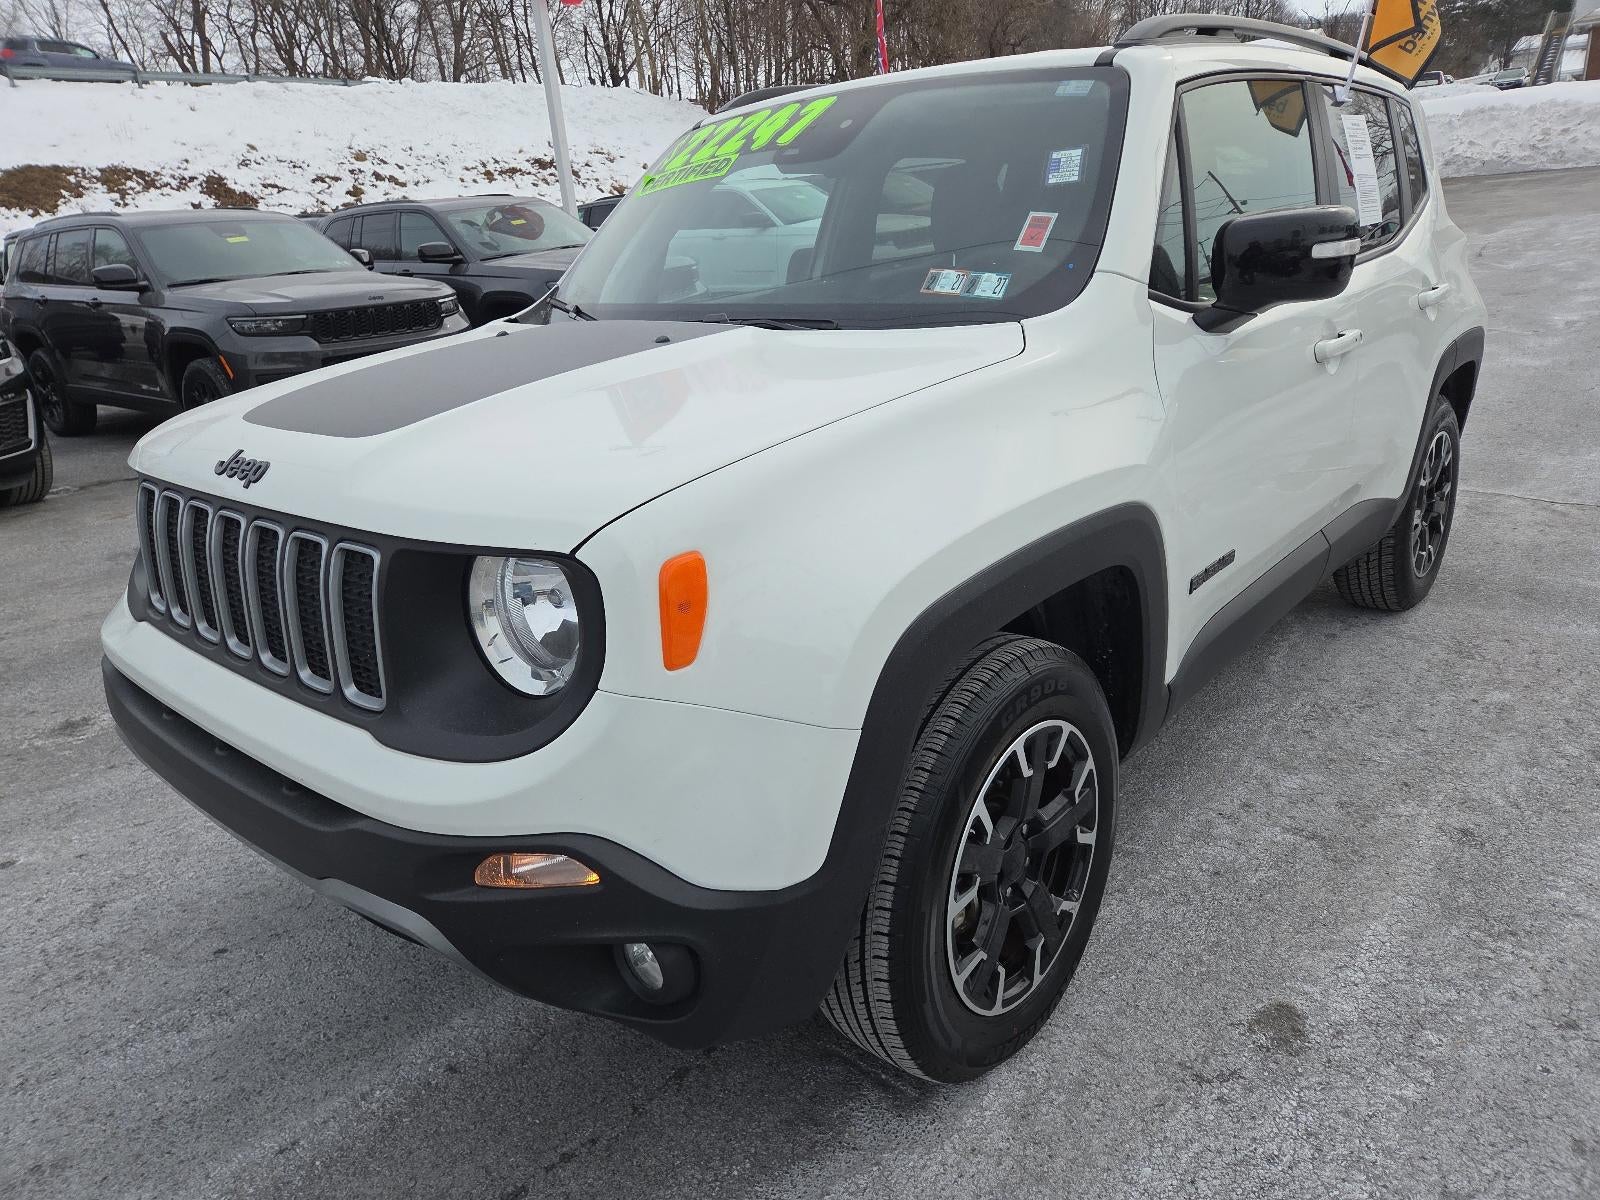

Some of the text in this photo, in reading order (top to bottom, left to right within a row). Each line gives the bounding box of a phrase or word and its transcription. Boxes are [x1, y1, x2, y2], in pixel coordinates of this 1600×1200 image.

[951, 273, 967, 291] 27
[992, 276, 1009, 296] 27
[214, 449, 270, 489] Jeep
